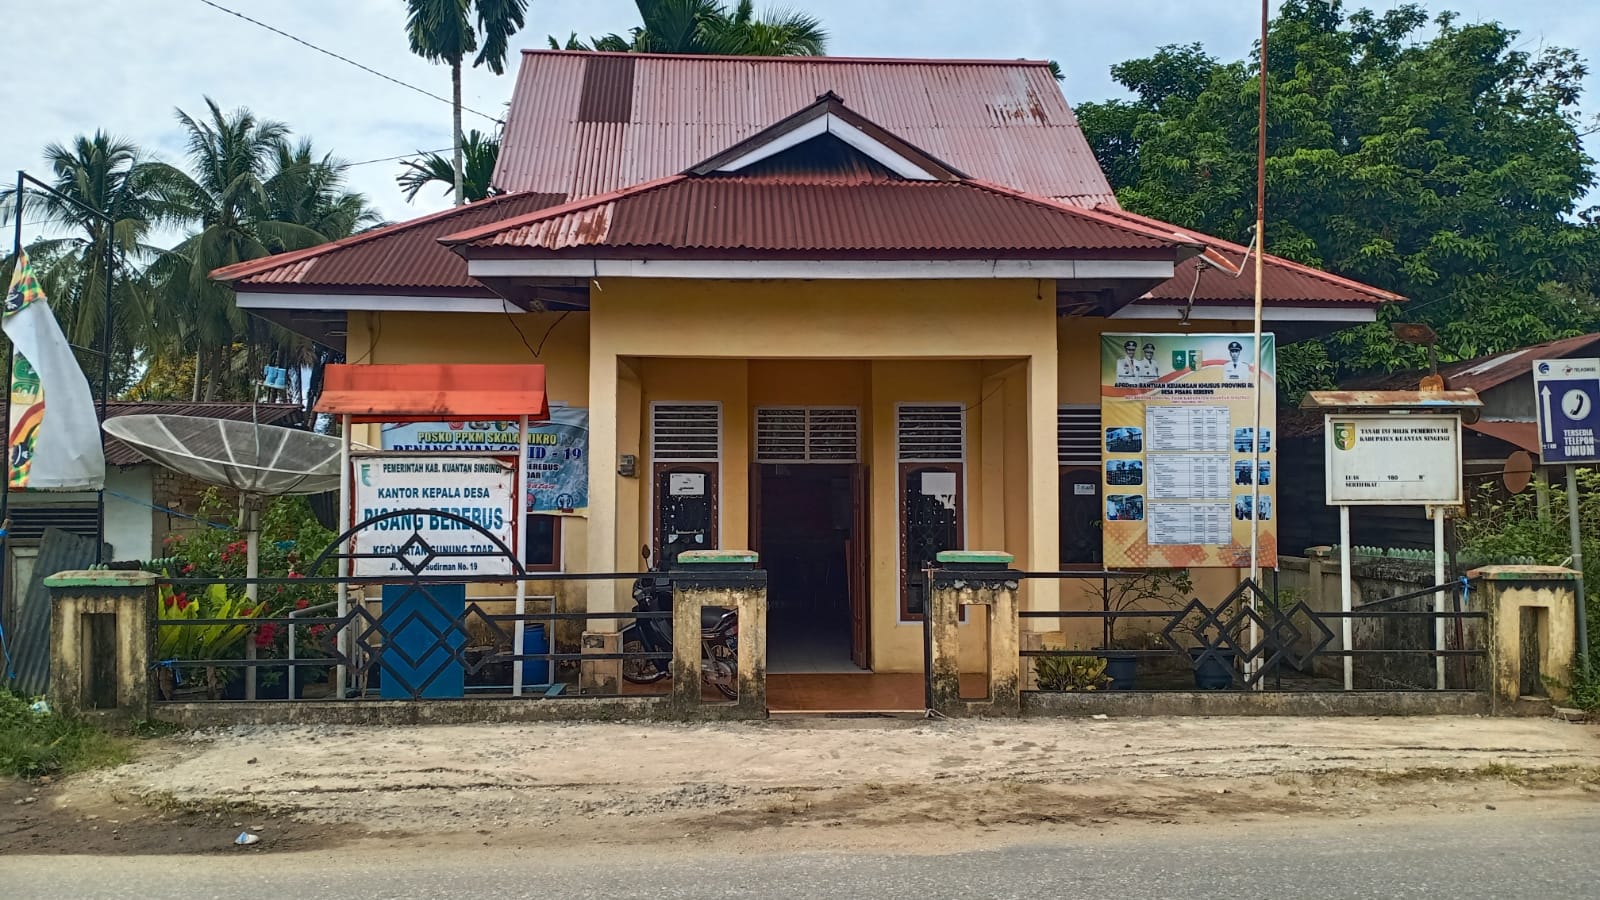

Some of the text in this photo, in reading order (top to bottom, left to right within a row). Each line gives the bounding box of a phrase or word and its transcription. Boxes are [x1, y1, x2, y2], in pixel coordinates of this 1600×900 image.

[418, 432, 453, 444] POSKO
[455, 432, 486, 444] PPKM
[487, 432, 520, 444] SKALA
[1563, 429, 1593, 437] TERSEDIA
[1563, 436, 1594, 445] TELEPON
[564, 447, 582, 460] 19
[1564, 445, 1595, 456] UMUM
[383, 463, 424, 473] PEMERINTAH
[425, 463, 441, 473] KAB.
[442, 463, 472, 473] KUANTAN
[527, 463, 559, 471] EREBUS
[378, 487, 490, 499] KANTOR KEPALA DESA
[364, 507, 503, 531] PISANG BEREBUS
[457, 562, 469, 570] No.
[470, 562, 478, 570] 19
